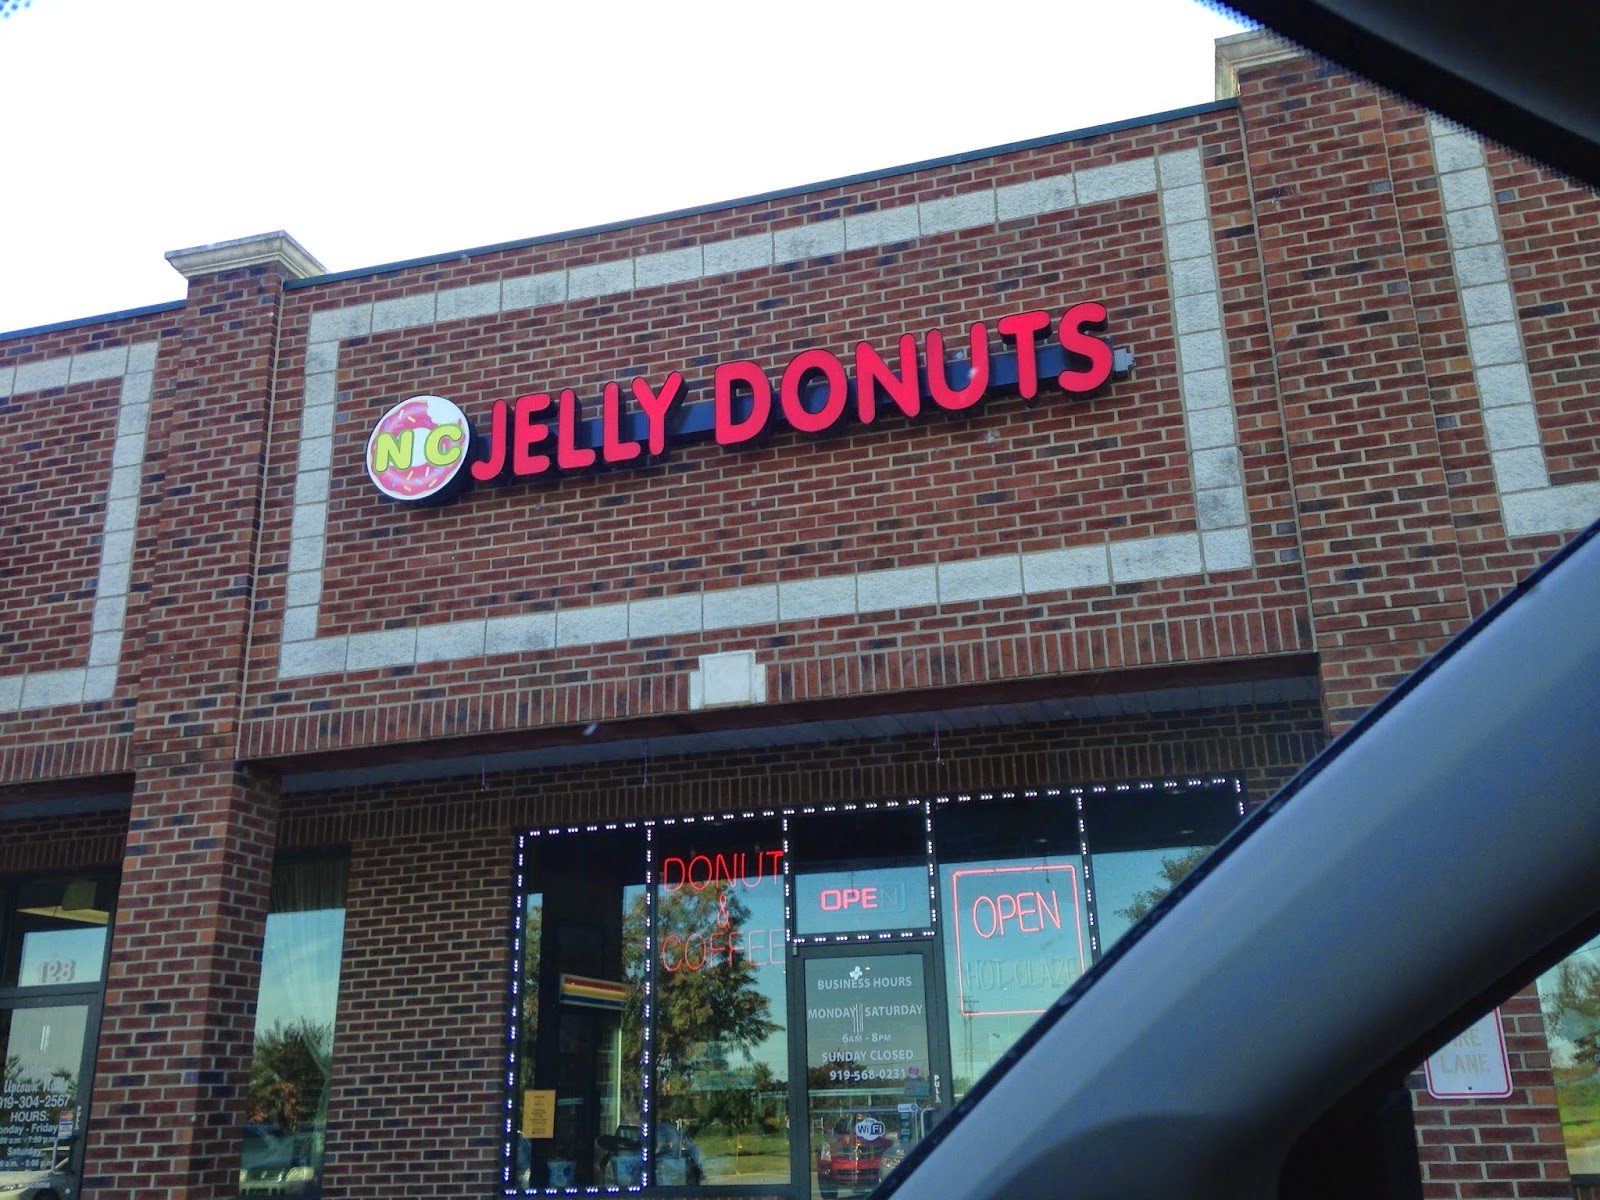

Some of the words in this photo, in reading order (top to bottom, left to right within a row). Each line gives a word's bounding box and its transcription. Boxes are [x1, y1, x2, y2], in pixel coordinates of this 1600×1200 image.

[471, 370, 688, 482] JELLY
[712, 301, 1114, 446] DONUTS
[716, 893, 731, 928] &
[972, 890, 1061, 938] OPEN
[661, 929, 786, 972] COFFEE
[817, 979, 871, 990] BUSINESS
[873, 976, 912, 988] HOURS
[966, 959, 1004, 991] HOT
[807, 1006, 857, 1019] MONDAY
[864, 1005, 923, 1017] SATURDAY
[822, 1051, 867, 1062] SUNDAY
[870, 1049, 914, 1061] CLOSED
[1440, 1053, 1491, 1074] LANE
[829, 1068, 906, 1081] 919-568-0231
[4, 1079, 38, 1097] Uptown
[933, 1074, 942, 1103] PULL
[0, 1094, 72, 1109] 919-304-2567
[10, 1110, 50, 1122] HOURS:
[0, 1124, 24, 1136] onday
[31, 1123, 59, 1134] Friday
[7, 1146, 42, 1157] Saturday
